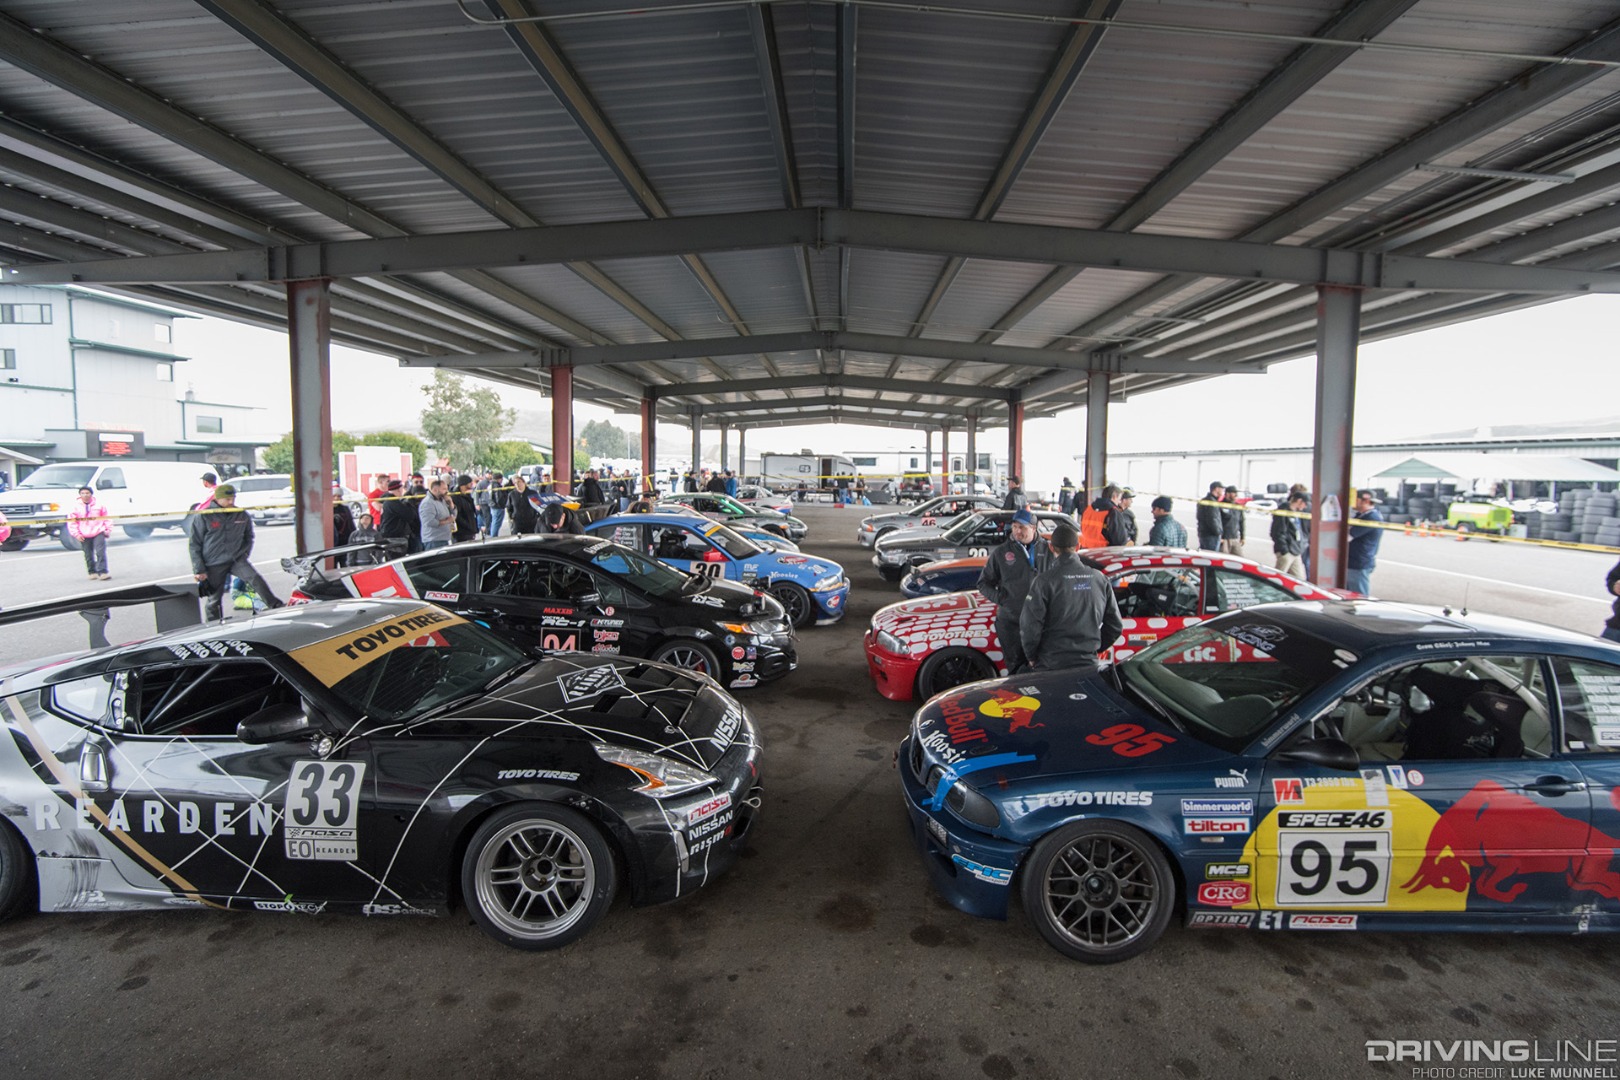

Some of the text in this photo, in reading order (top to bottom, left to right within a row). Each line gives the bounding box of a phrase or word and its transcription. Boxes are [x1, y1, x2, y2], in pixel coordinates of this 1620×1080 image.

[696, 563, 721, 578] 30
[543, 607, 573, 615] MAXXIS
[541, 619, 586, 627] RC-1
[336, 611, 453, 661] TOYO TIRES
[1225, 626, 1276, 652] RACING
[710, 705, 742, 752] NISSA
[945, 713, 986, 744] Bull
[921, 730, 966, 764] Hoosi
[1085, 723, 1178, 758] 95
[498, 769, 580, 781] TOYO TIRES
[1214, 778, 1245, 788] PUMA
[292, 763, 355, 826] 33
[1038, 790, 1153, 807] TOYO TIRES
[690, 796, 729, 821] nasa
[1183, 801, 1251, 812] bimmerworld
[35, 799, 274, 836] REARDEN
[688, 810, 733, 841] NISSAN
[1188, 820, 1247, 832] tilton
[690, 825, 732, 856] nismo
[1208, 865, 1249, 875] MCS
[1290, 840, 1379, 896] 95
[1203, 887, 1246, 900] CRC
[1195, 914, 1248, 924] OPTIMA
[1259, 911, 1283, 929] E1
[1292, 915, 1354, 924] nasa
